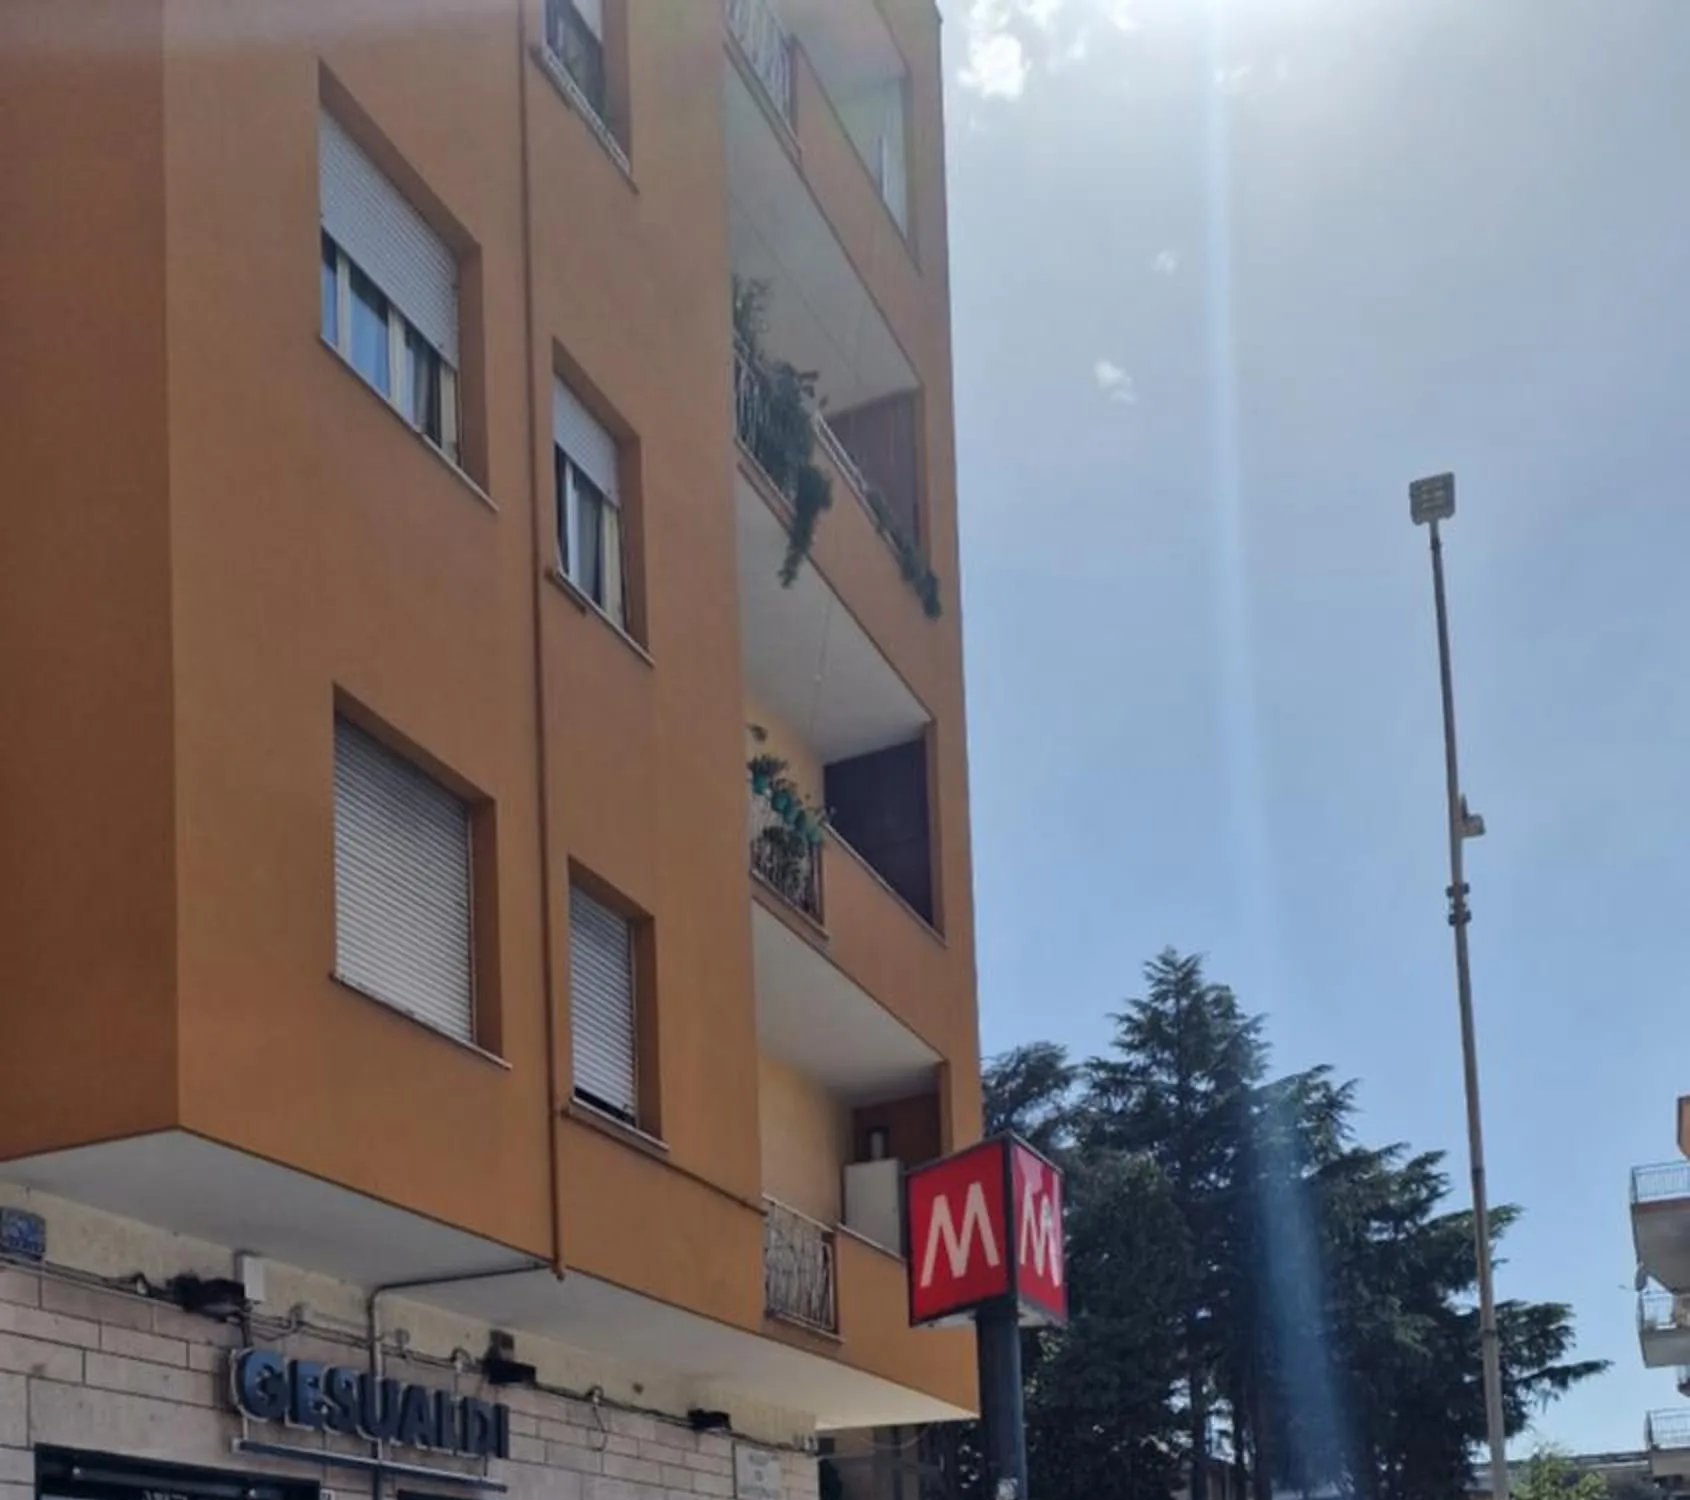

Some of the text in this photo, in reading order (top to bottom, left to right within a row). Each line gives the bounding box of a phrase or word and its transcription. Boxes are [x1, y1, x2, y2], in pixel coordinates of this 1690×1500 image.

[920, 1181, 1000, 1287] M
[1019, 1182, 1062, 1287] M
[235, 1349, 510, 1458] GESUALDI
